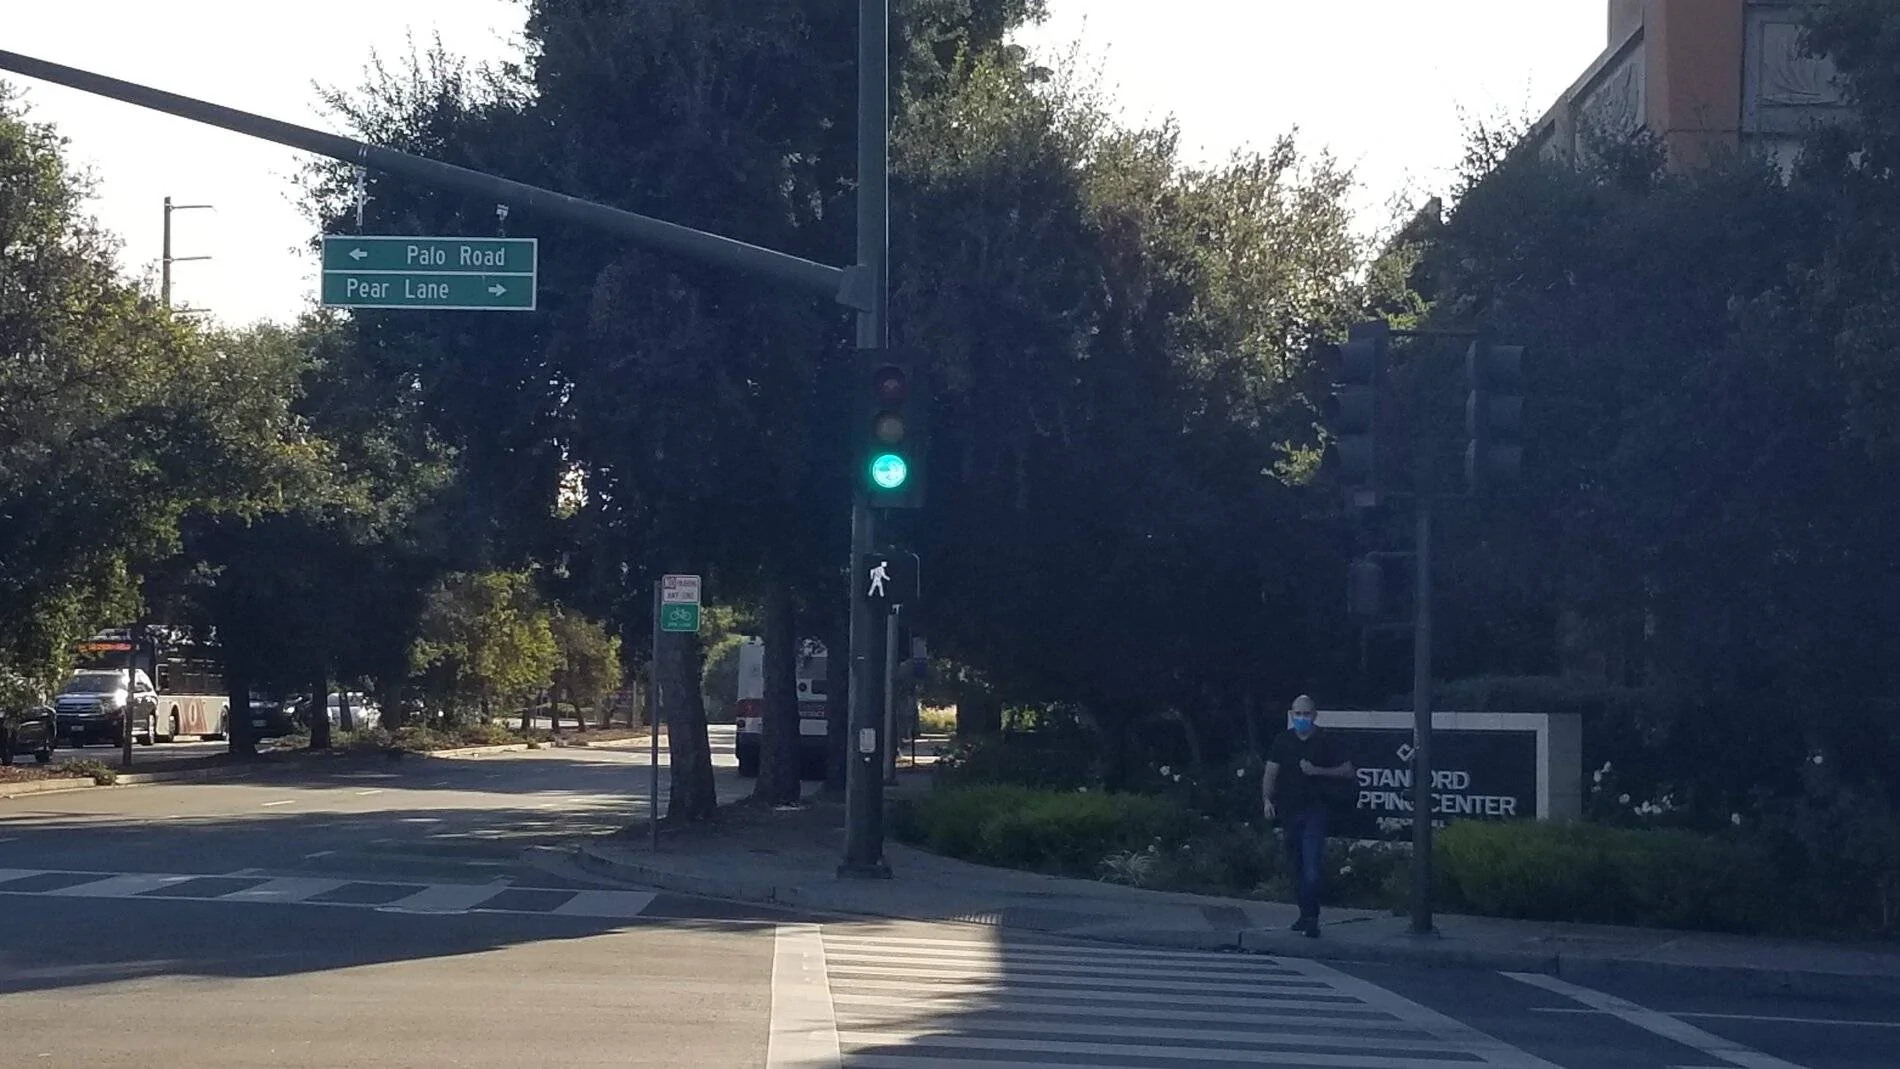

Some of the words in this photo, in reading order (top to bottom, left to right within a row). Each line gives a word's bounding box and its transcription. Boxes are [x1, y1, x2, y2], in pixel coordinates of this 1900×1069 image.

[406, 245, 446, 265] Palo
[460, 246, 505, 266] Road
[346, 278, 389, 298] Pear
[404, 279, 449, 299] Lane
[1356, 768, 1471, 790] STANRD
